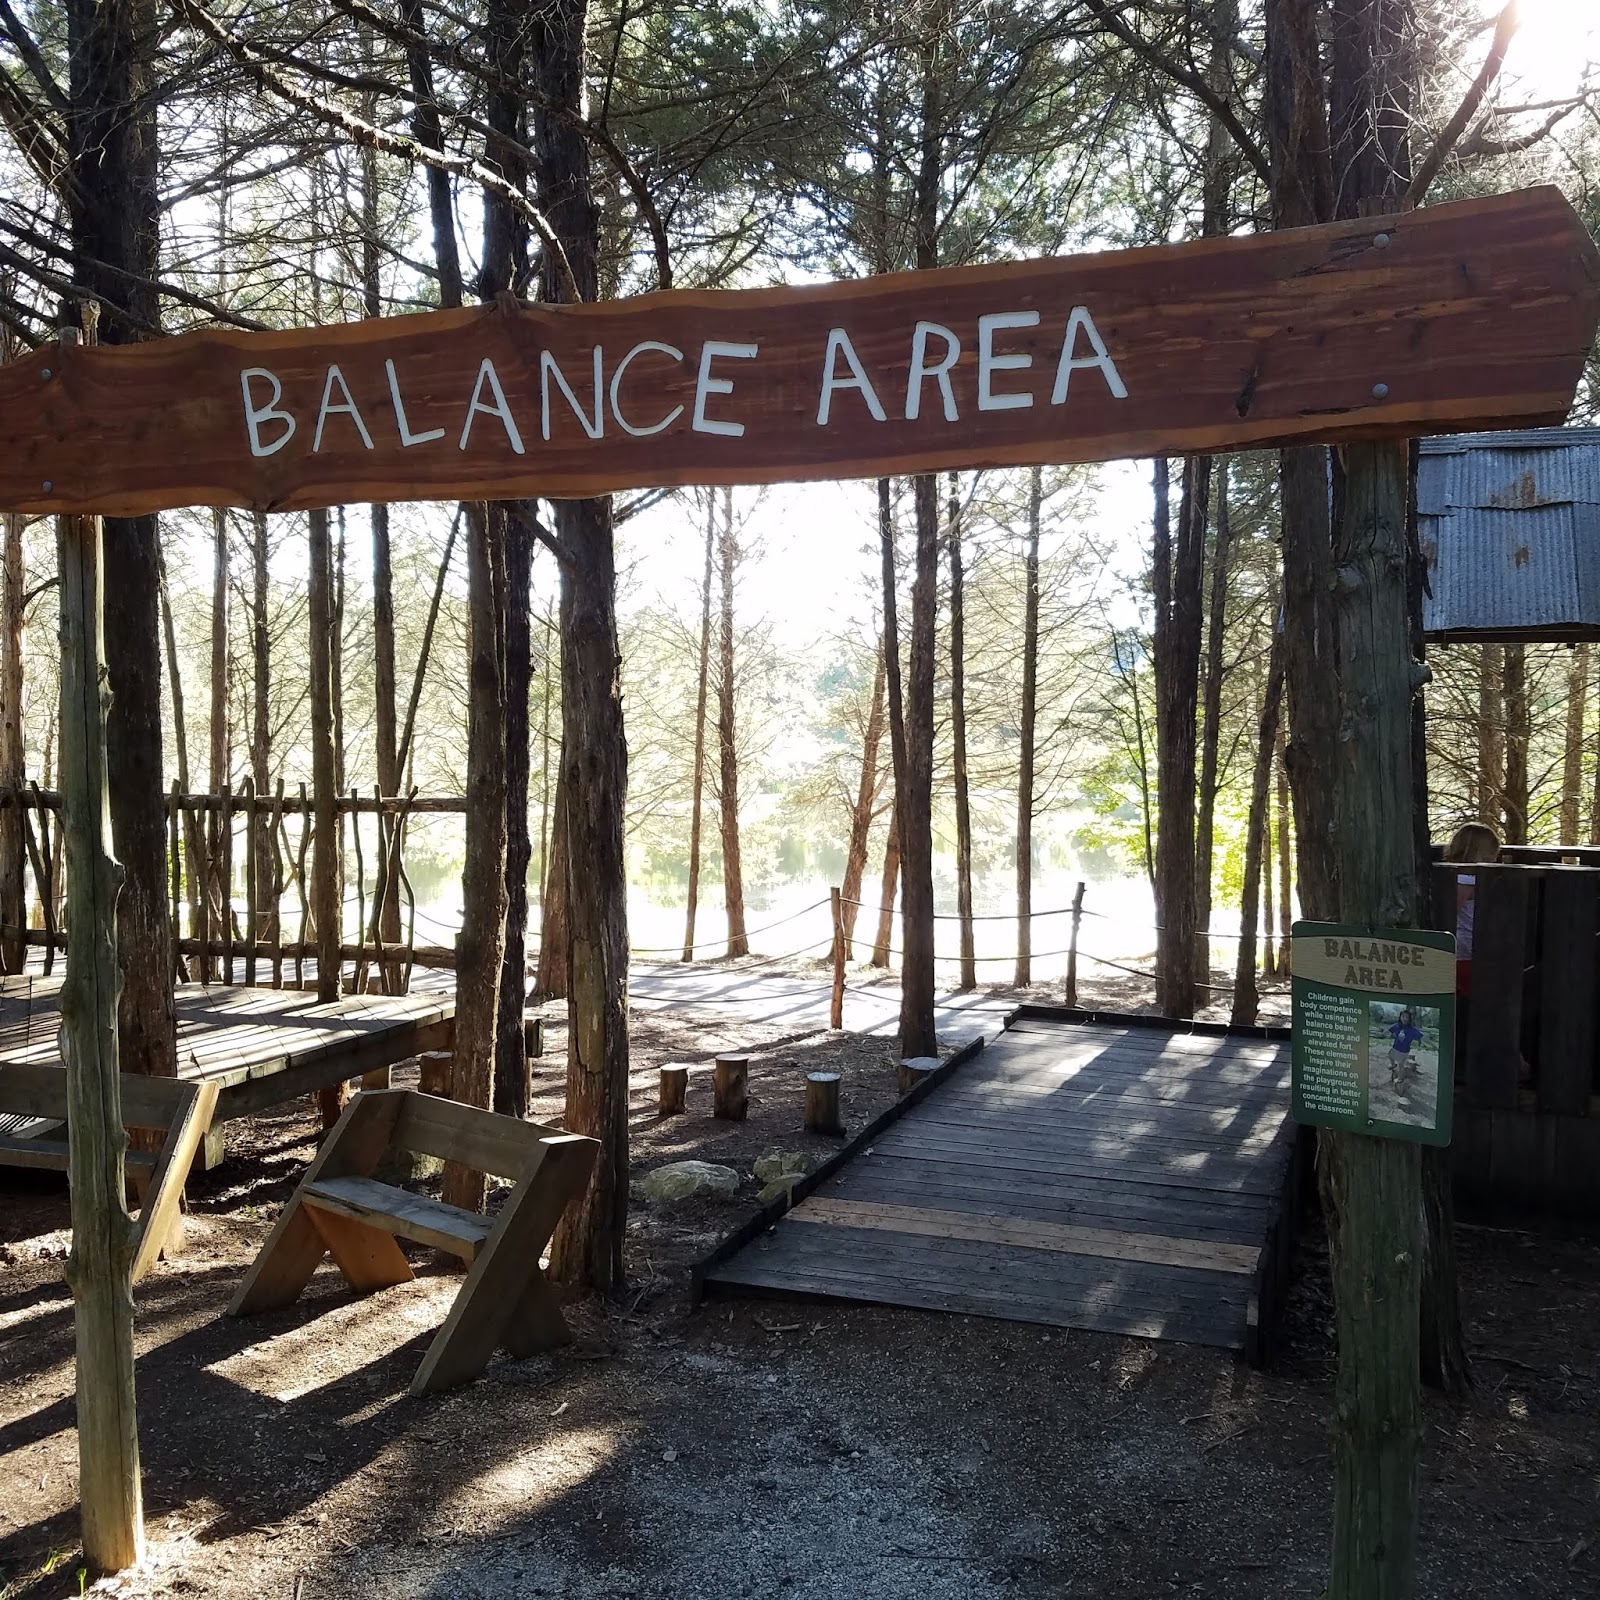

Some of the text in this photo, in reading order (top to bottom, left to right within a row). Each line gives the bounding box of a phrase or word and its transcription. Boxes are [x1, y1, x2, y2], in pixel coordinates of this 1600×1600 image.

[240, 305, 1129, 457] BALANCE AREA
[1324, 938, 1425, 967] BALANCE
[1344, 964, 1403, 990] AREA
[1308, 992, 1355, 1005] Children gain
[1300, 1000, 1362, 1014] body competence
[1305, 1010, 1357, 1023] while using the
[1305, 1019, 1356, 1033] balance beam,
[1302, 1029, 1324, 1038] stump
[1325, 1032, 1345, 1040] steps
[1308, 1038, 1337, 1048] elevated
[1303, 1046, 1358, 1060] These elements
[1309, 1055, 1351, 1068] inspire their
[1302, 1064, 1348, 1078] imaginations
[1300, 1083, 1330, 1094] resulting
[1340, 1088, 1361, 1097] better
[1302, 1093, 1350, 1105] concentration
[1305, 1101, 1356, 1115] the classroom.
